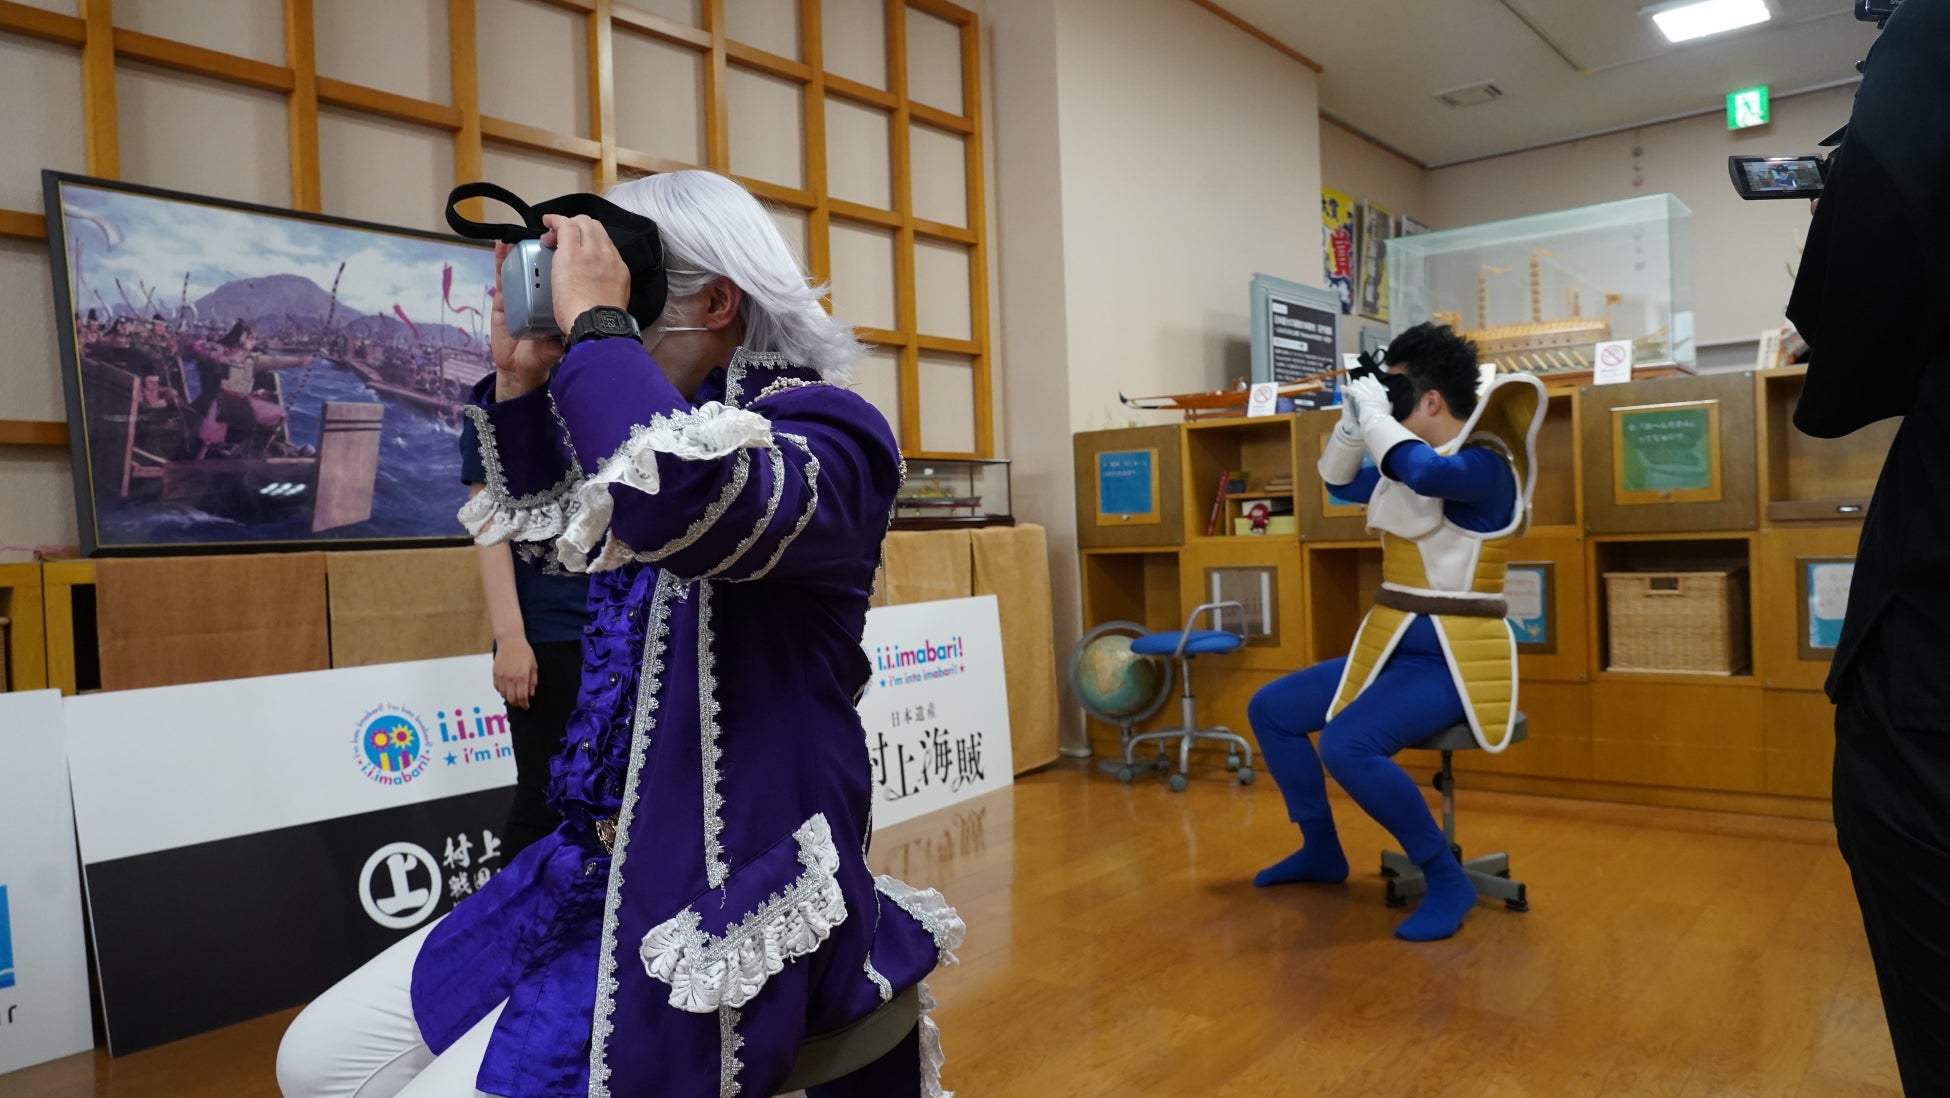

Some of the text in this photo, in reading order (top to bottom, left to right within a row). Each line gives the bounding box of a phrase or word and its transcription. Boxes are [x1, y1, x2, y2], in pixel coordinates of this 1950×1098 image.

[877, 636, 963, 671] i.i.imabari!
[891, 702, 937, 728] 日本遺産
[360, 753, 431, 786] i.i.imabari!
[464, 747, 492, 764] i'm
[443, 829, 501, 869] 村上
